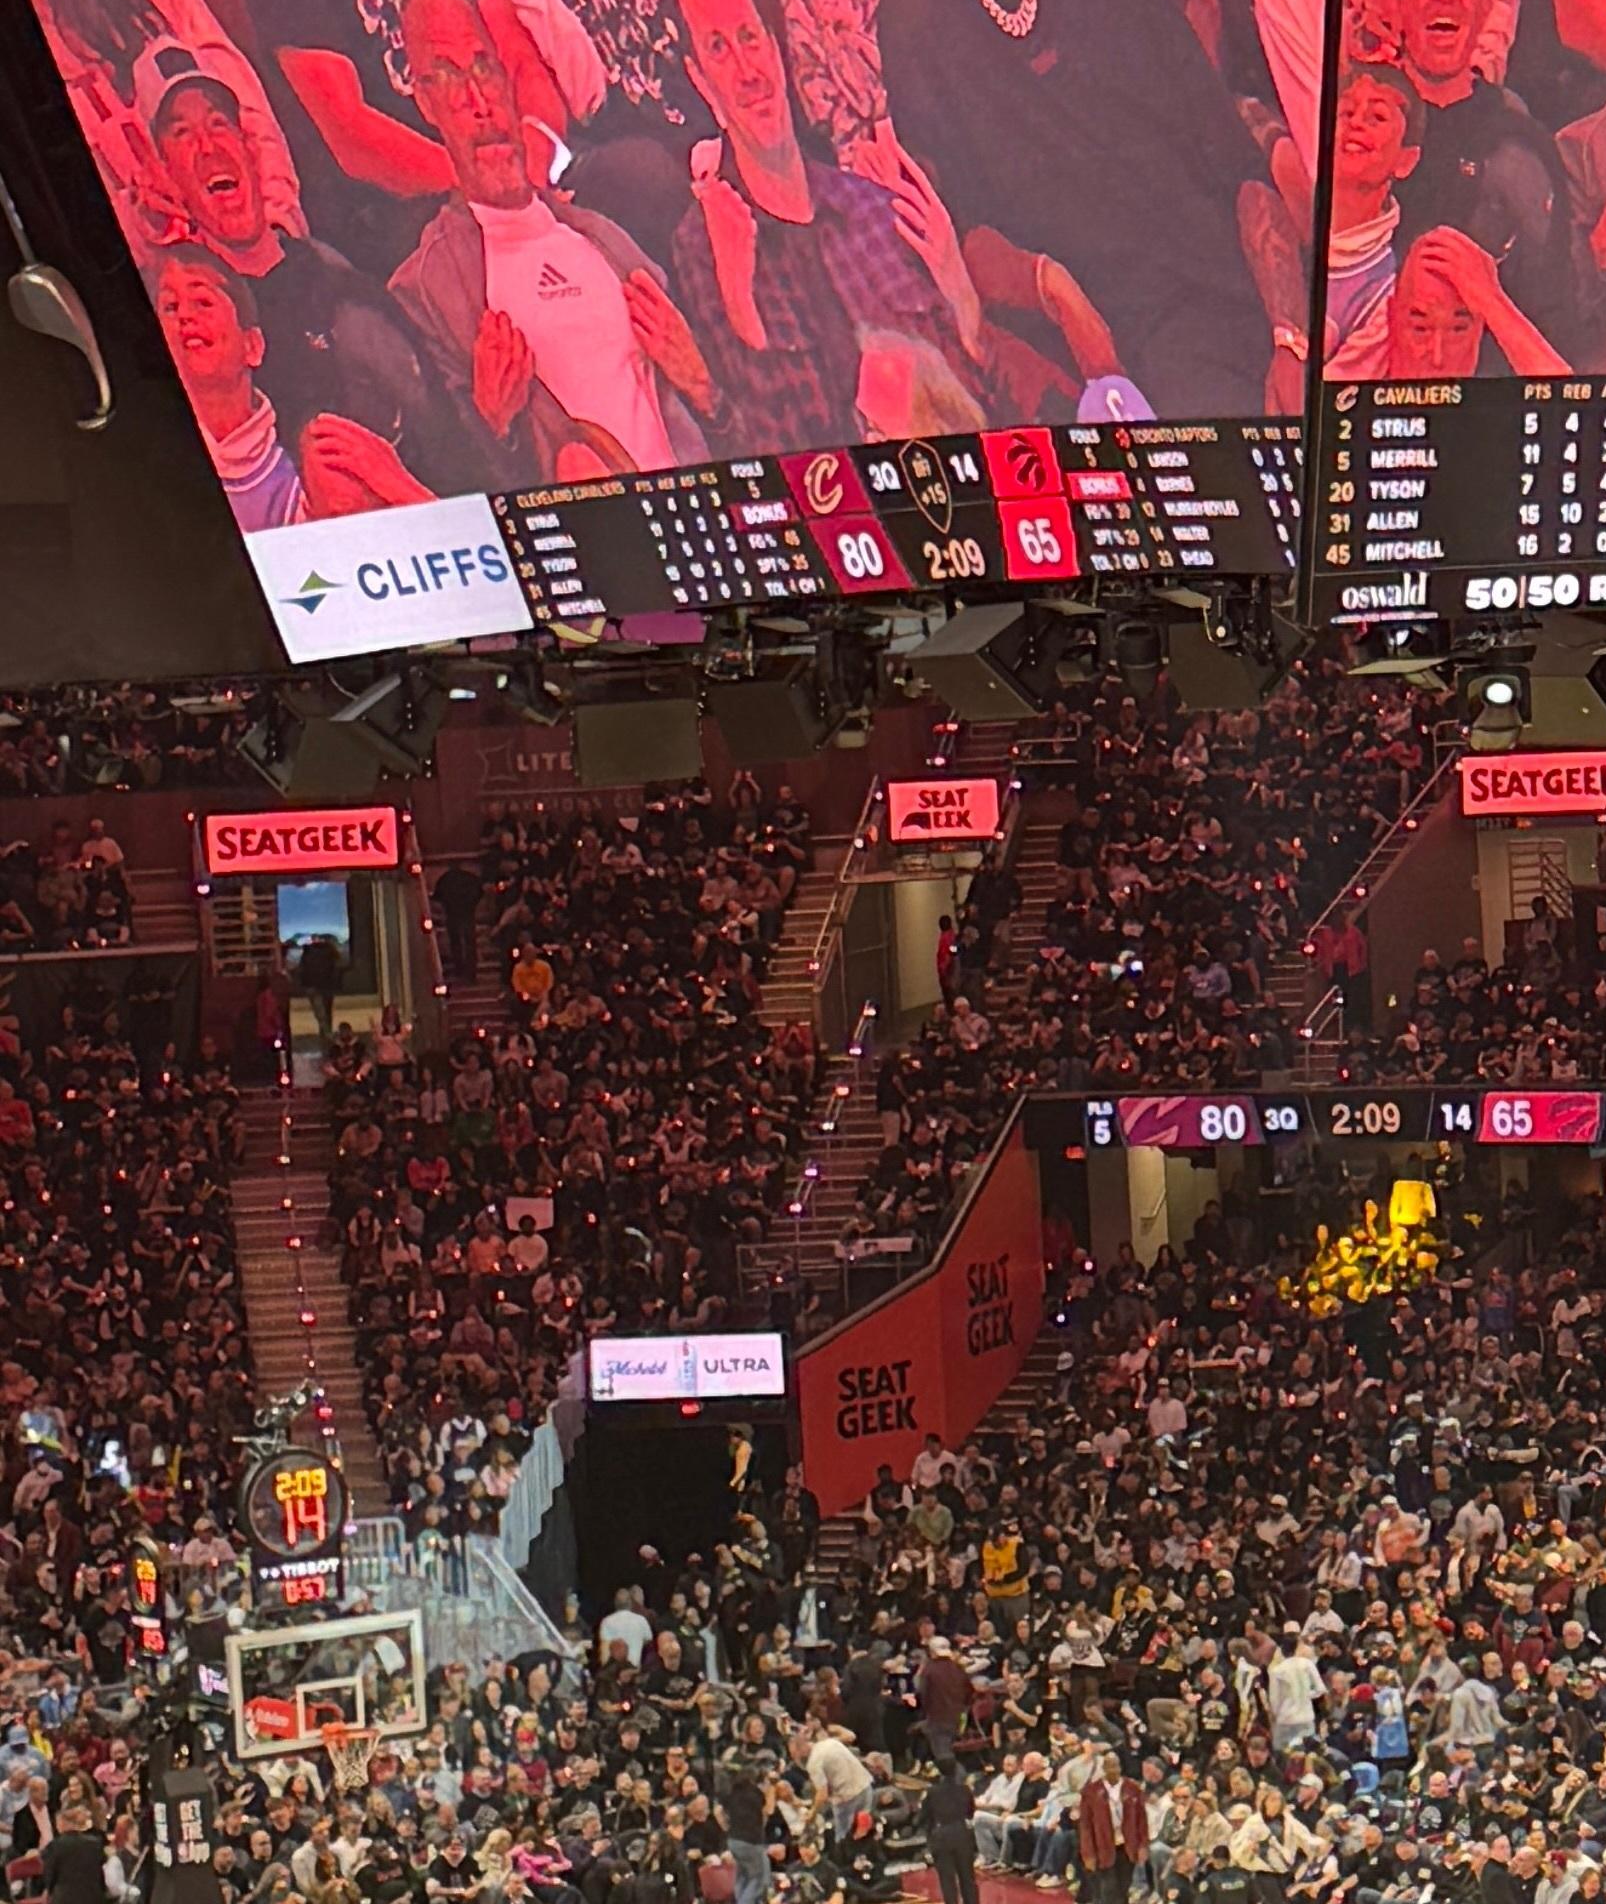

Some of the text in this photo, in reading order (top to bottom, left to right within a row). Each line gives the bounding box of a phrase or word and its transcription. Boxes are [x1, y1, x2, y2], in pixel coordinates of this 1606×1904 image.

[1373, 384, 1462, 405] CAVALIERS
[1524, 384, 1552, 401] PTS
[1339, 418, 1426, 440] 2 STRUS
[869, 453, 980, 493] 3Q 14
[1338, 449, 1438, 472] 5 MERRILL
[1329, 480, 1426, 503] 20 TYSON
[1017, 518, 1062, 565] 65
[1328, 511, 1419, 533] 31 ALLEN
[357, 544, 508, 600] CLIFFS
[837, 535, 884, 578] 80
[922, 540, 986, 580] 2:09
[1326, 541, 1445, 565] 45 MITCHELL
[1342, 571, 1427, 610] oswald
[918, 788, 969, 811] SEAT
[912, 810, 972, 830] EEK
[216, 820, 387, 863] SEATGEEK
[1093, 1118, 1112, 1145] 5
[1200, 1100, 1532, 1140] 80 3Q 2:09 14 65
[966, 1254, 1009, 1302] SEAT
[967, 1307, 1016, 1358] GEEK
[703, 1358, 770, 1374] ULTRA
[838, 1361, 912, 1402] SEAT
[836, 1396, 918, 1440] GEEK
[276, 1468, 327, 1500] 2:09
[284, 1497, 326, 1545] 14
